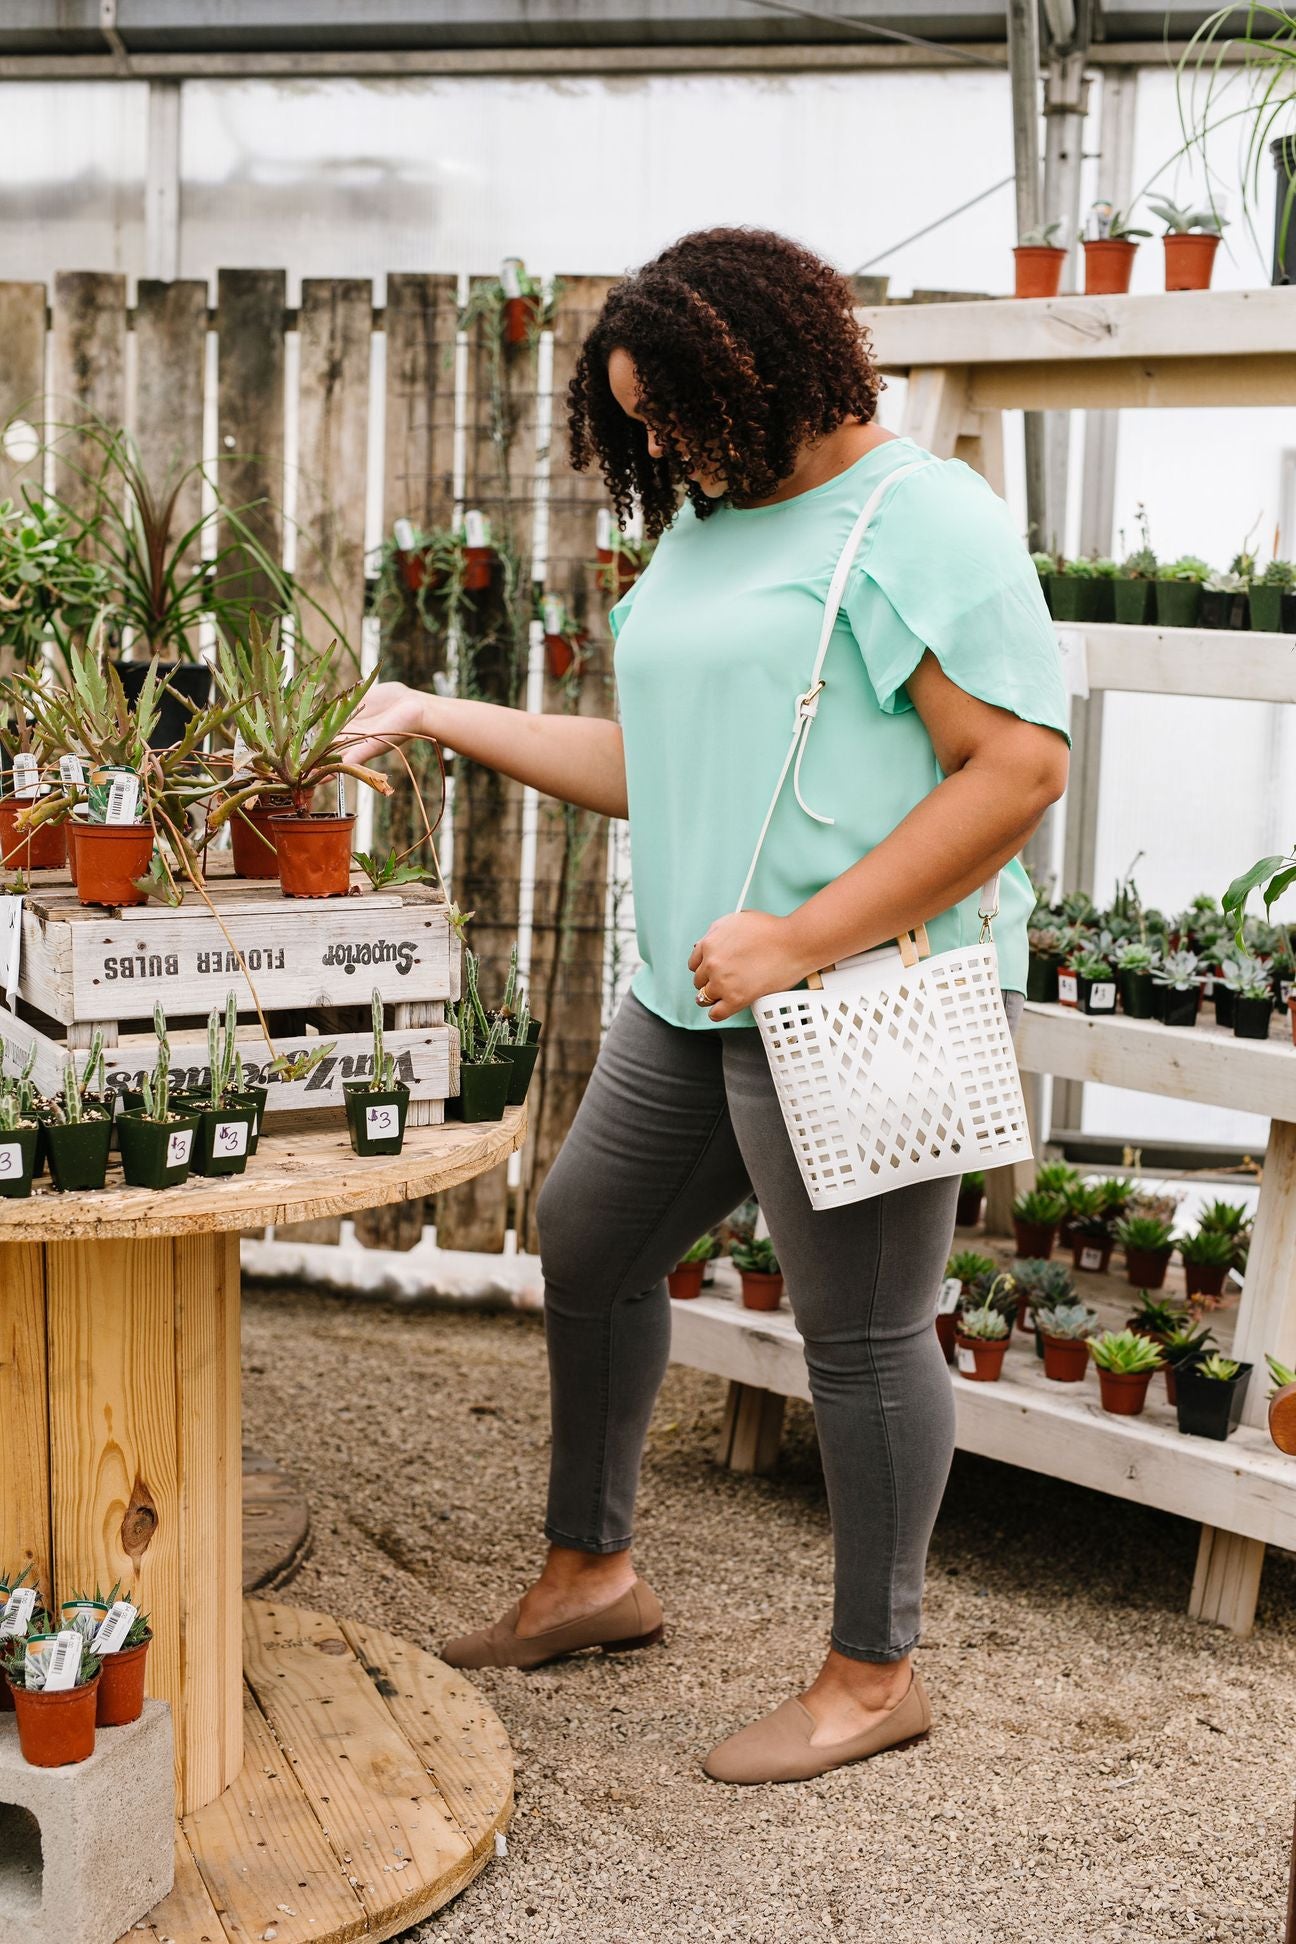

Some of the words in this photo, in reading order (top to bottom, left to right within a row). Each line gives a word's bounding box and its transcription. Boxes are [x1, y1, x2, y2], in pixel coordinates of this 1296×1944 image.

[104, 953, 179, 979] BULBS
[197, 948, 285, 974] FLOWER
[322, 939, 419, 976] Superior
[368, 1108, 391, 1129] $3
[171, 1136, 186, 1160] $3
[220, 1126, 238, 1151] $3
